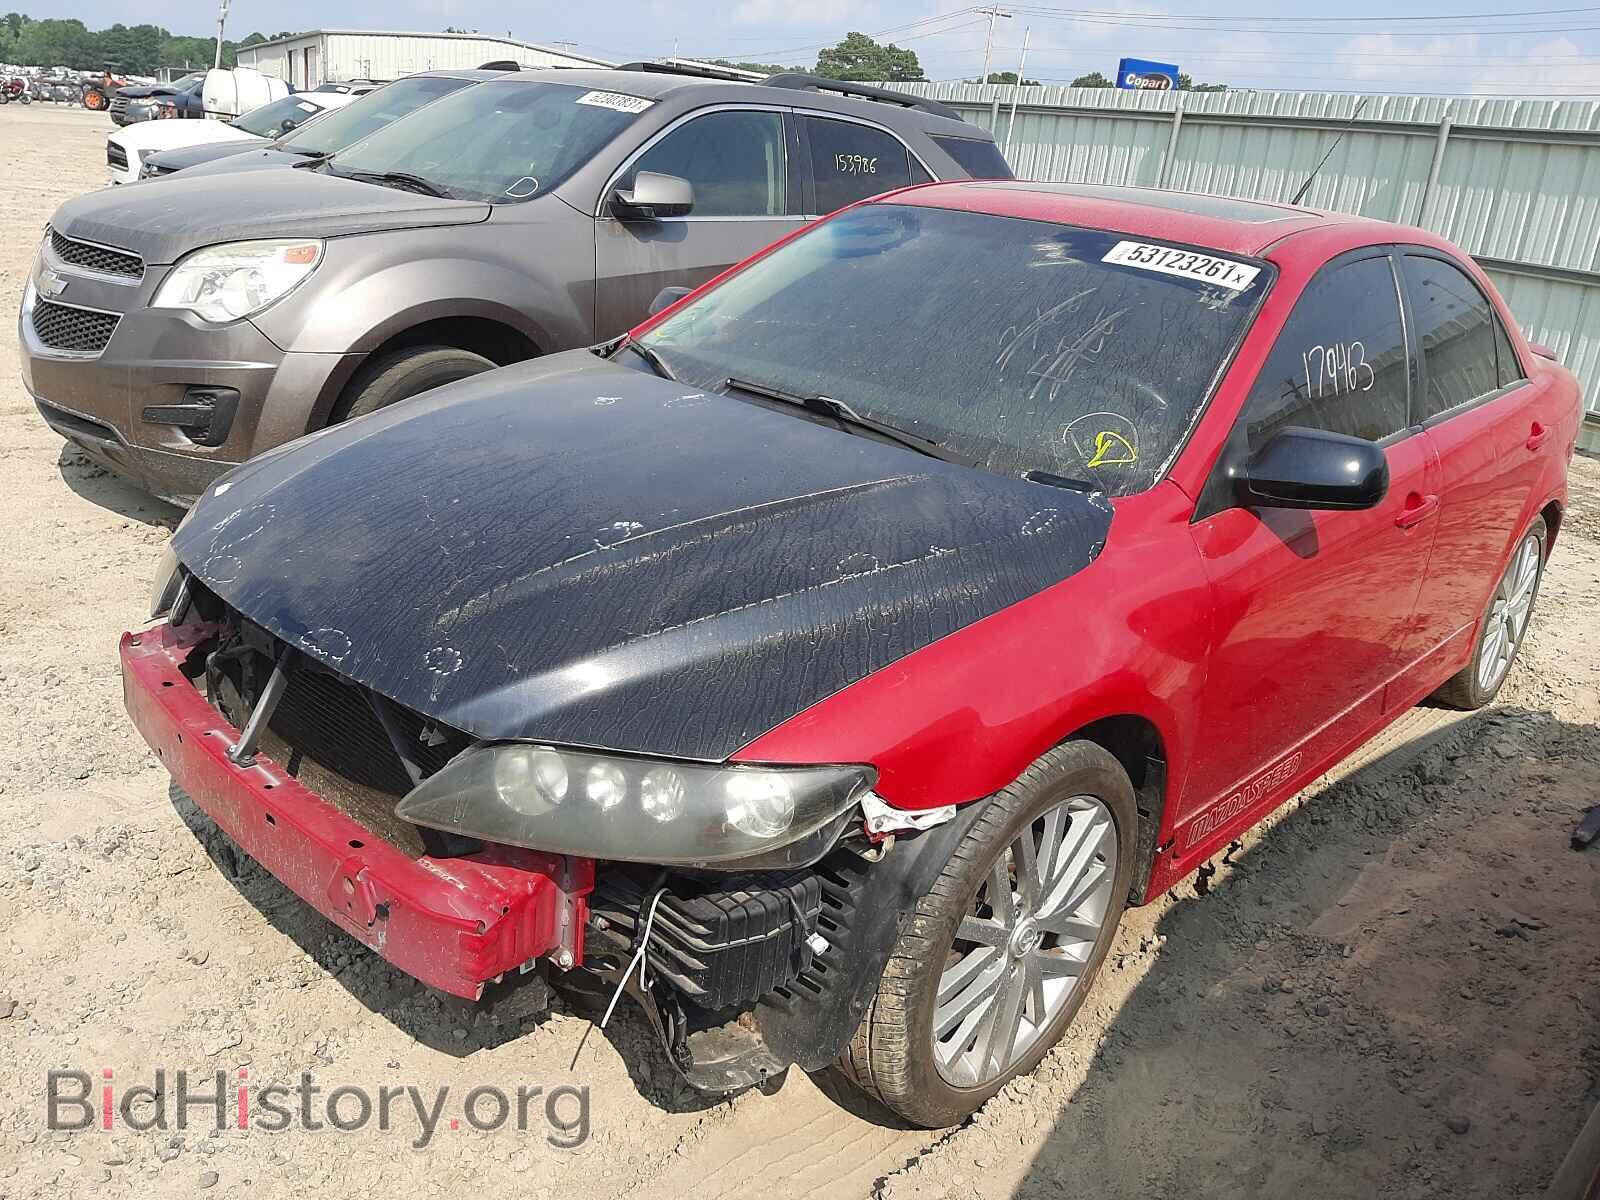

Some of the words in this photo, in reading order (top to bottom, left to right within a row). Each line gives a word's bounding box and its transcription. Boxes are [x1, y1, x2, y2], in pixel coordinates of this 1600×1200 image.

[1125, 73, 1168, 89] Copart
[1127, 245, 1237, 280] 53123261
[1303, 341, 1374, 398] 179463
[1185, 752, 1303, 849] MAZDASPEED
